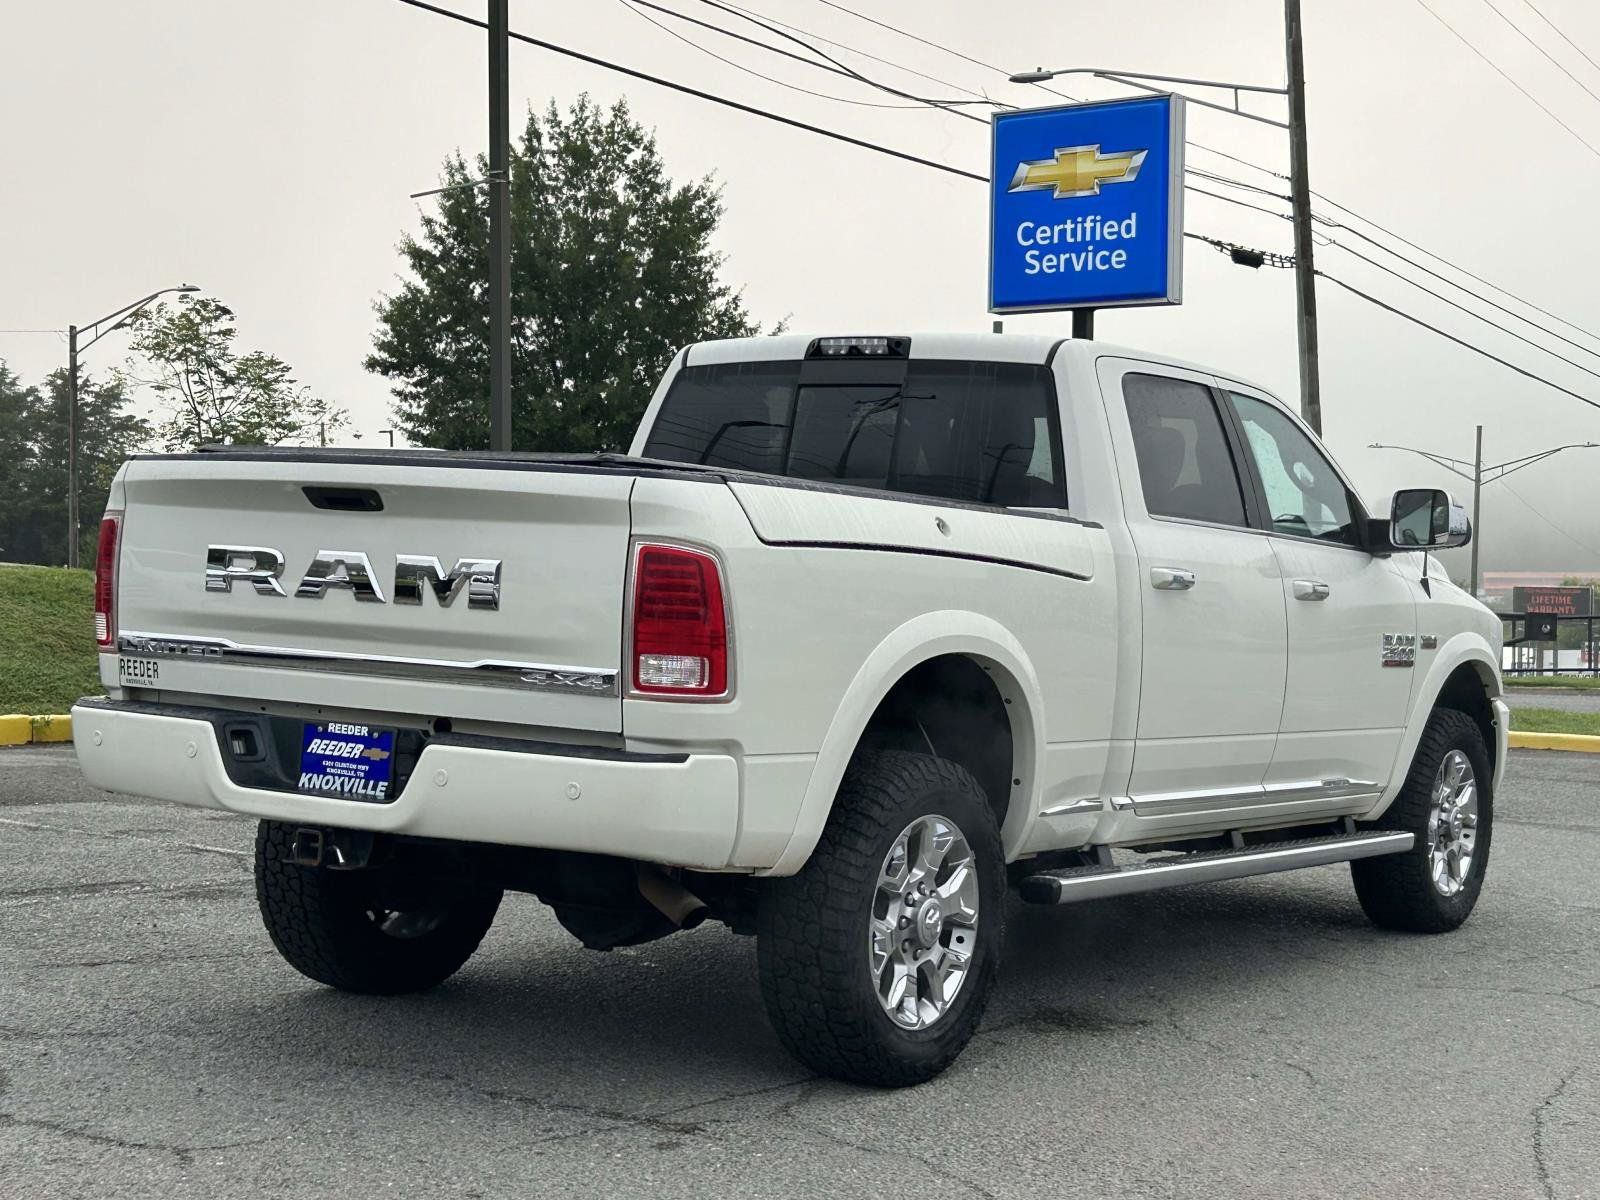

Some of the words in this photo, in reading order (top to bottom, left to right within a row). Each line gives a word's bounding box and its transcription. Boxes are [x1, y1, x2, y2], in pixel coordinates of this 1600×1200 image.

[1016, 212, 1137, 246] Certified
[1024, 245, 1127, 274] Service
[205, 544, 502, 611] RAM
[1530, 595, 1572, 604] LIFETIME
[120, 658, 159, 679] REEDER
[327, 722, 369, 737] REEDER
[307, 739, 364, 758] REEDER
[298, 772, 389, 799] KNOXVILLE
